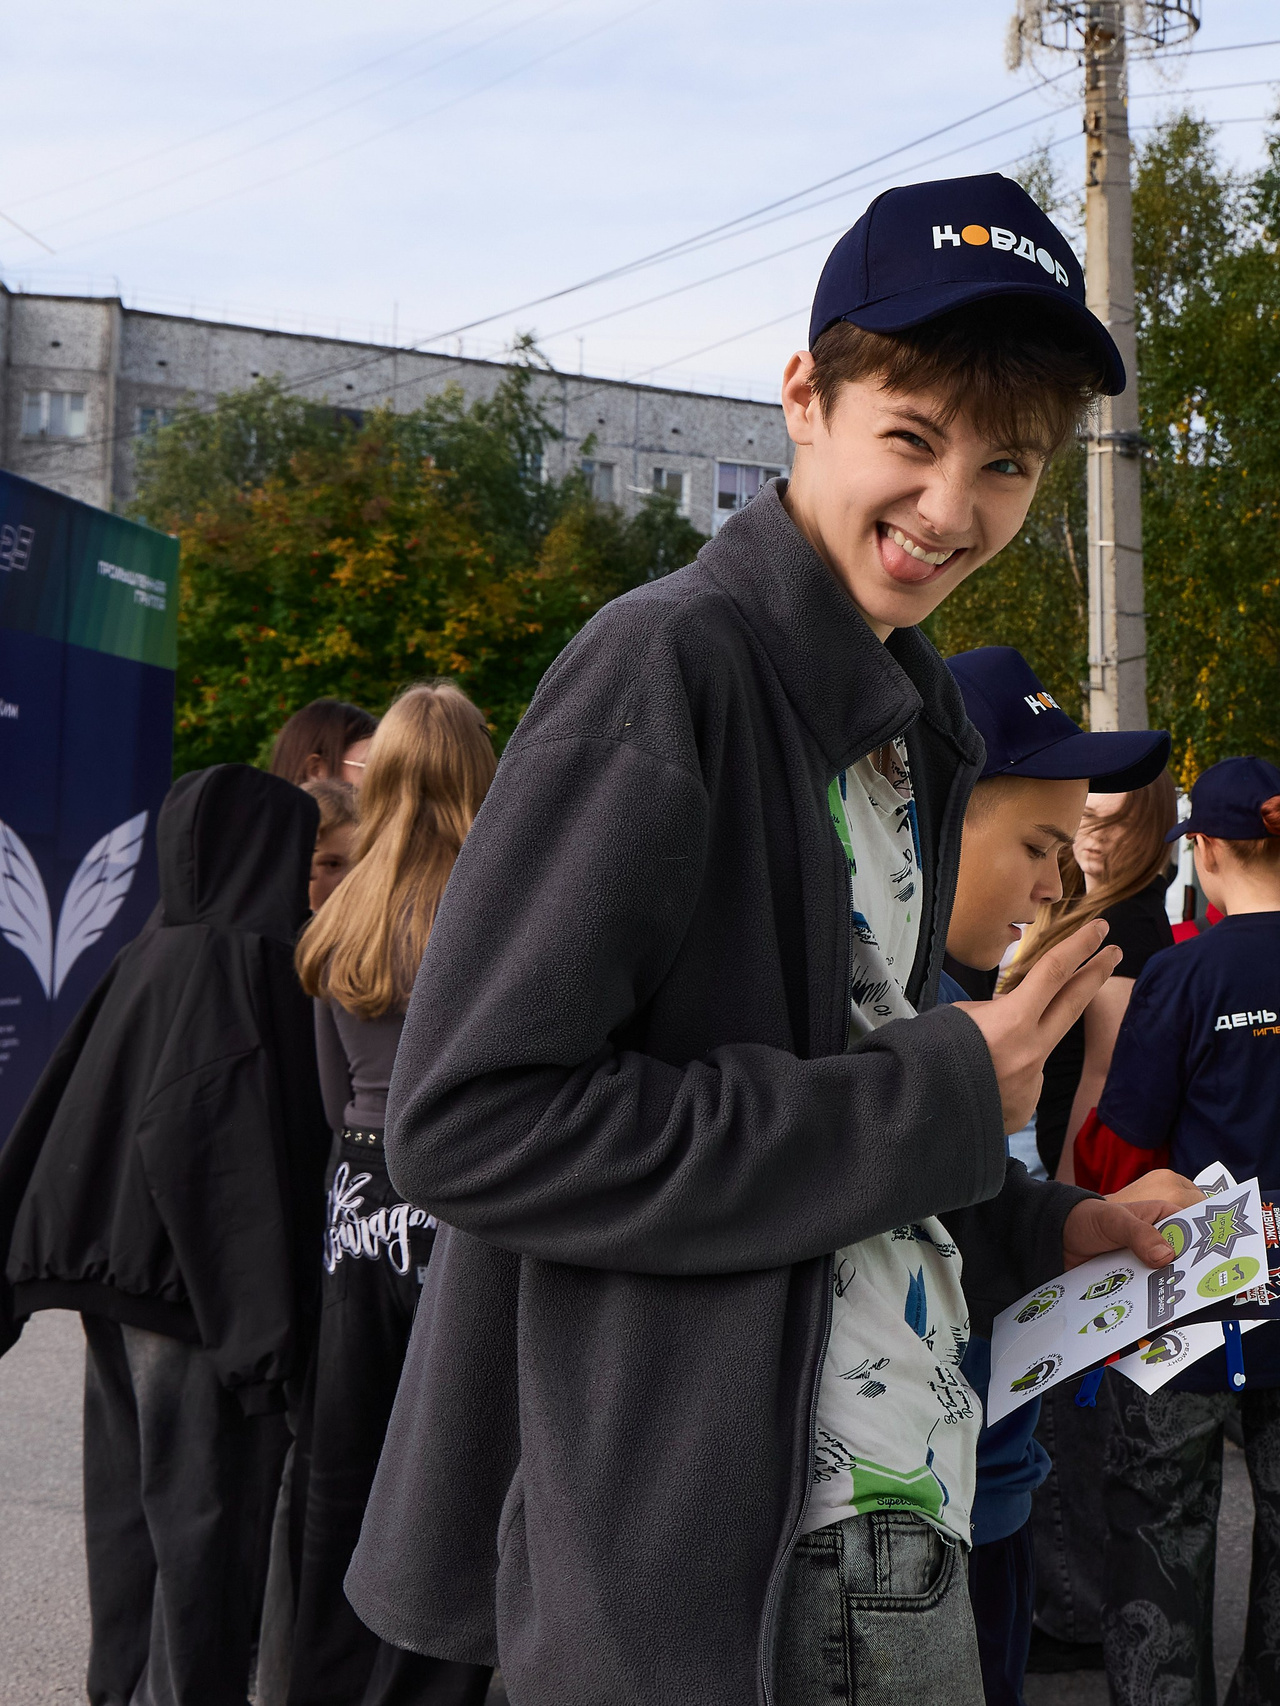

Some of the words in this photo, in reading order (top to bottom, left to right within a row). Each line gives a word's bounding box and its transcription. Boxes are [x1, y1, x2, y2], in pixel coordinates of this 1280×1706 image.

[1214, 1009, 1278, 1032] ДЕНЬ
[1263, 1210, 1277, 1241] ДВИЖ!
[1167, 1342, 1190, 1367] РЕМОНТ
